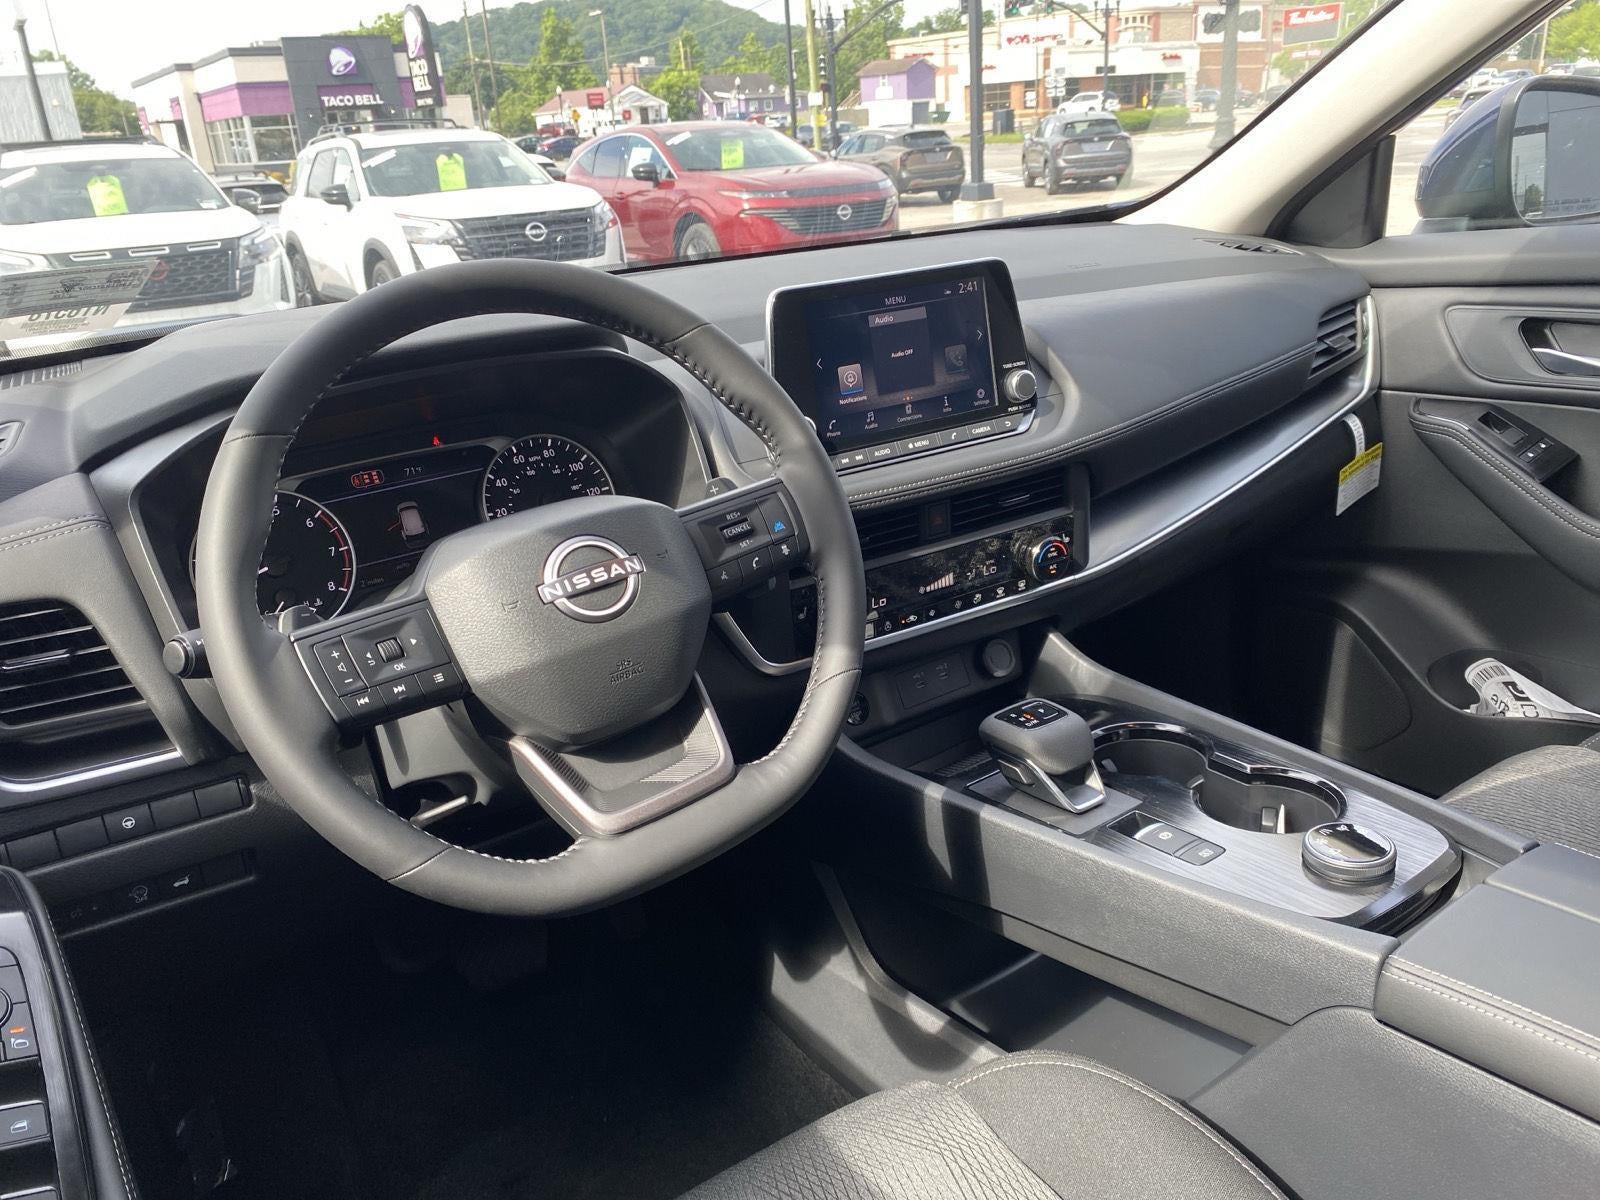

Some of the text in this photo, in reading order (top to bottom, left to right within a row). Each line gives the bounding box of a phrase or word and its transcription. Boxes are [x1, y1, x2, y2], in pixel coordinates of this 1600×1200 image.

[320, 94, 384, 107] TACO BELL
[958, 281, 978, 294] 2:41
[885, 296, 907, 305] MENU
[874, 315, 894, 325] Audio
[971, 426, 991, 434] CAMERA
[914, 439, 929, 448] MENU
[542, 449, 556, 458] 80
[874, 448, 891, 457] AUDIO
[513, 455, 525, 465] 60
[568, 461, 584, 472] 100
[495, 478, 508, 487] 40
[586, 487, 601, 497] 120
[495, 507, 508, 518] 20
[306, 518, 314, 528] 6
[728, 522, 751, 537] CANCEL
[328, 546, 335, 557] 7
[542, 558, 642, 601] NISSAN
[327, 581, 336, 591] 8
[393, 661, 407, 672] OK
[609, 665, 646, 685] AIRBAG
